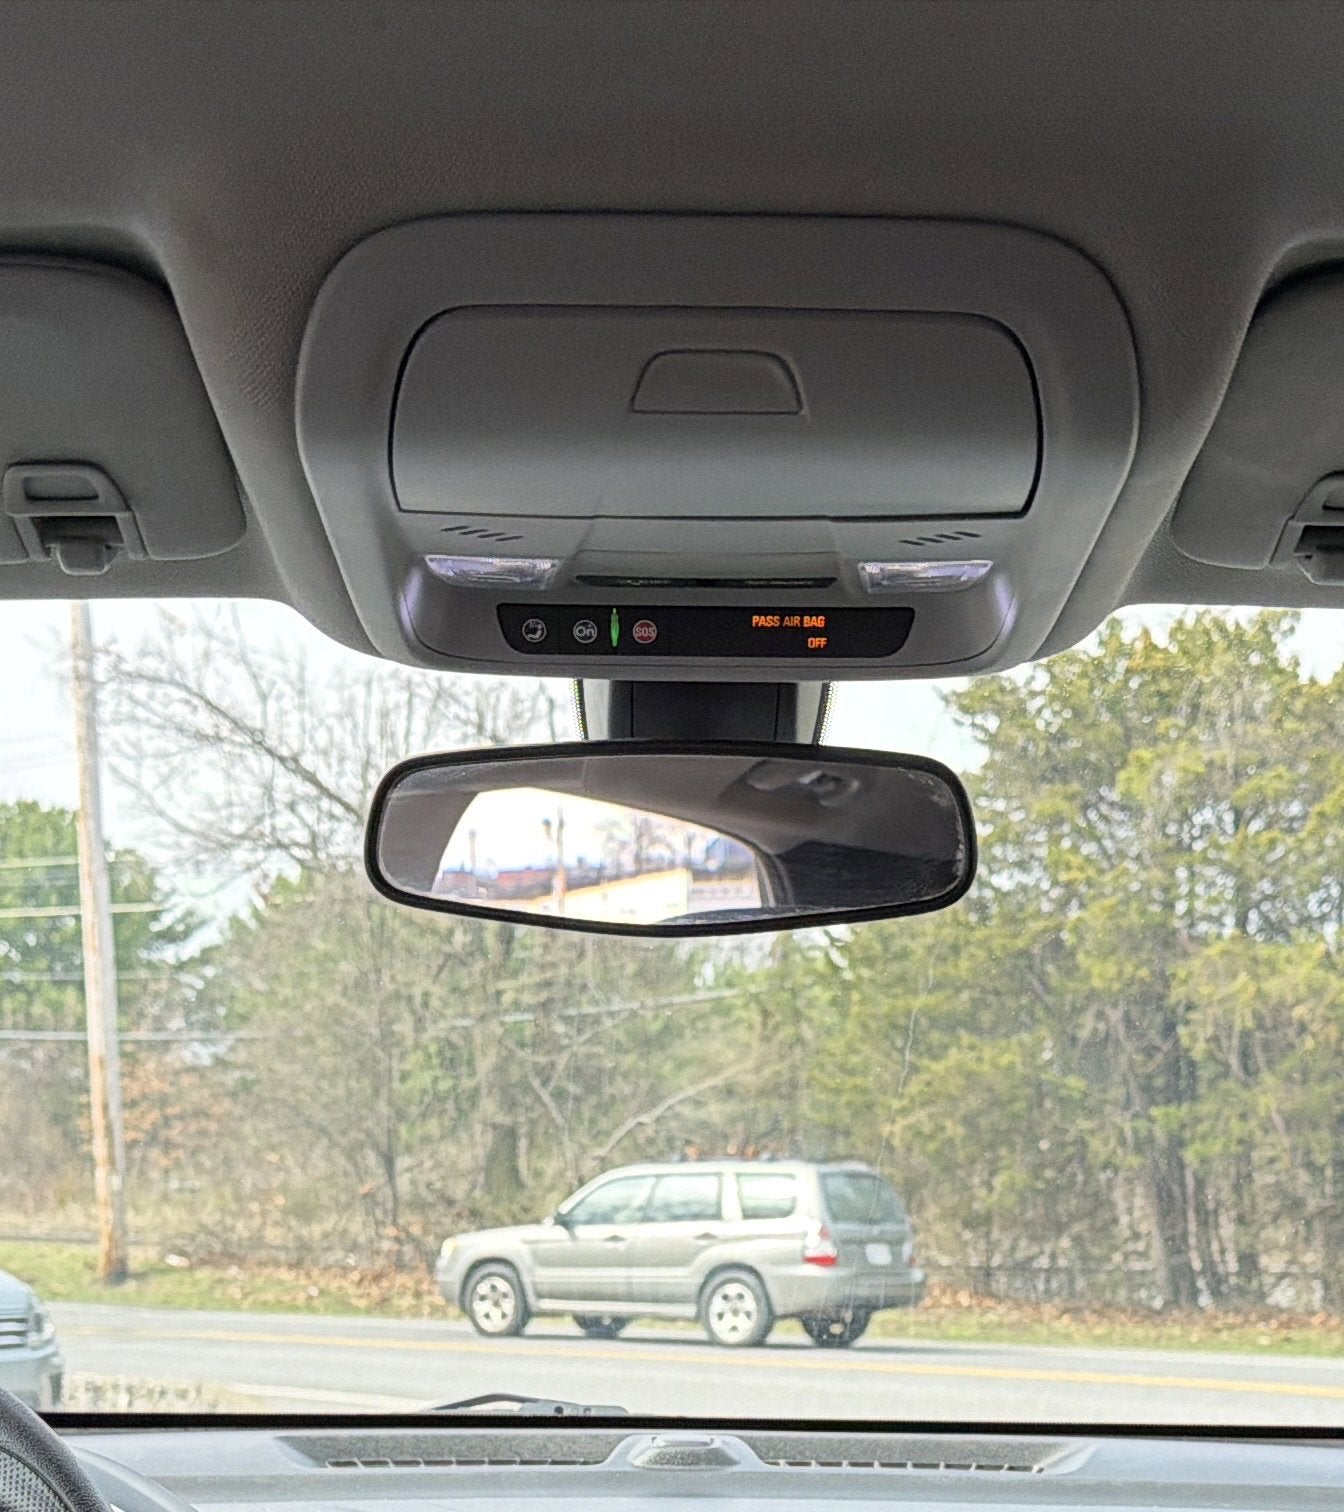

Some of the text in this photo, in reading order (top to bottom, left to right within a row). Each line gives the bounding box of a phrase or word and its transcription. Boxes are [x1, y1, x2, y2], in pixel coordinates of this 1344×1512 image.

[752, 615, 825, 628] PASS AIR BAG
[575, 623, 595, 637] On
[635, 626, 656, 637] SOS
[807, 637, 827, 648] OFF
